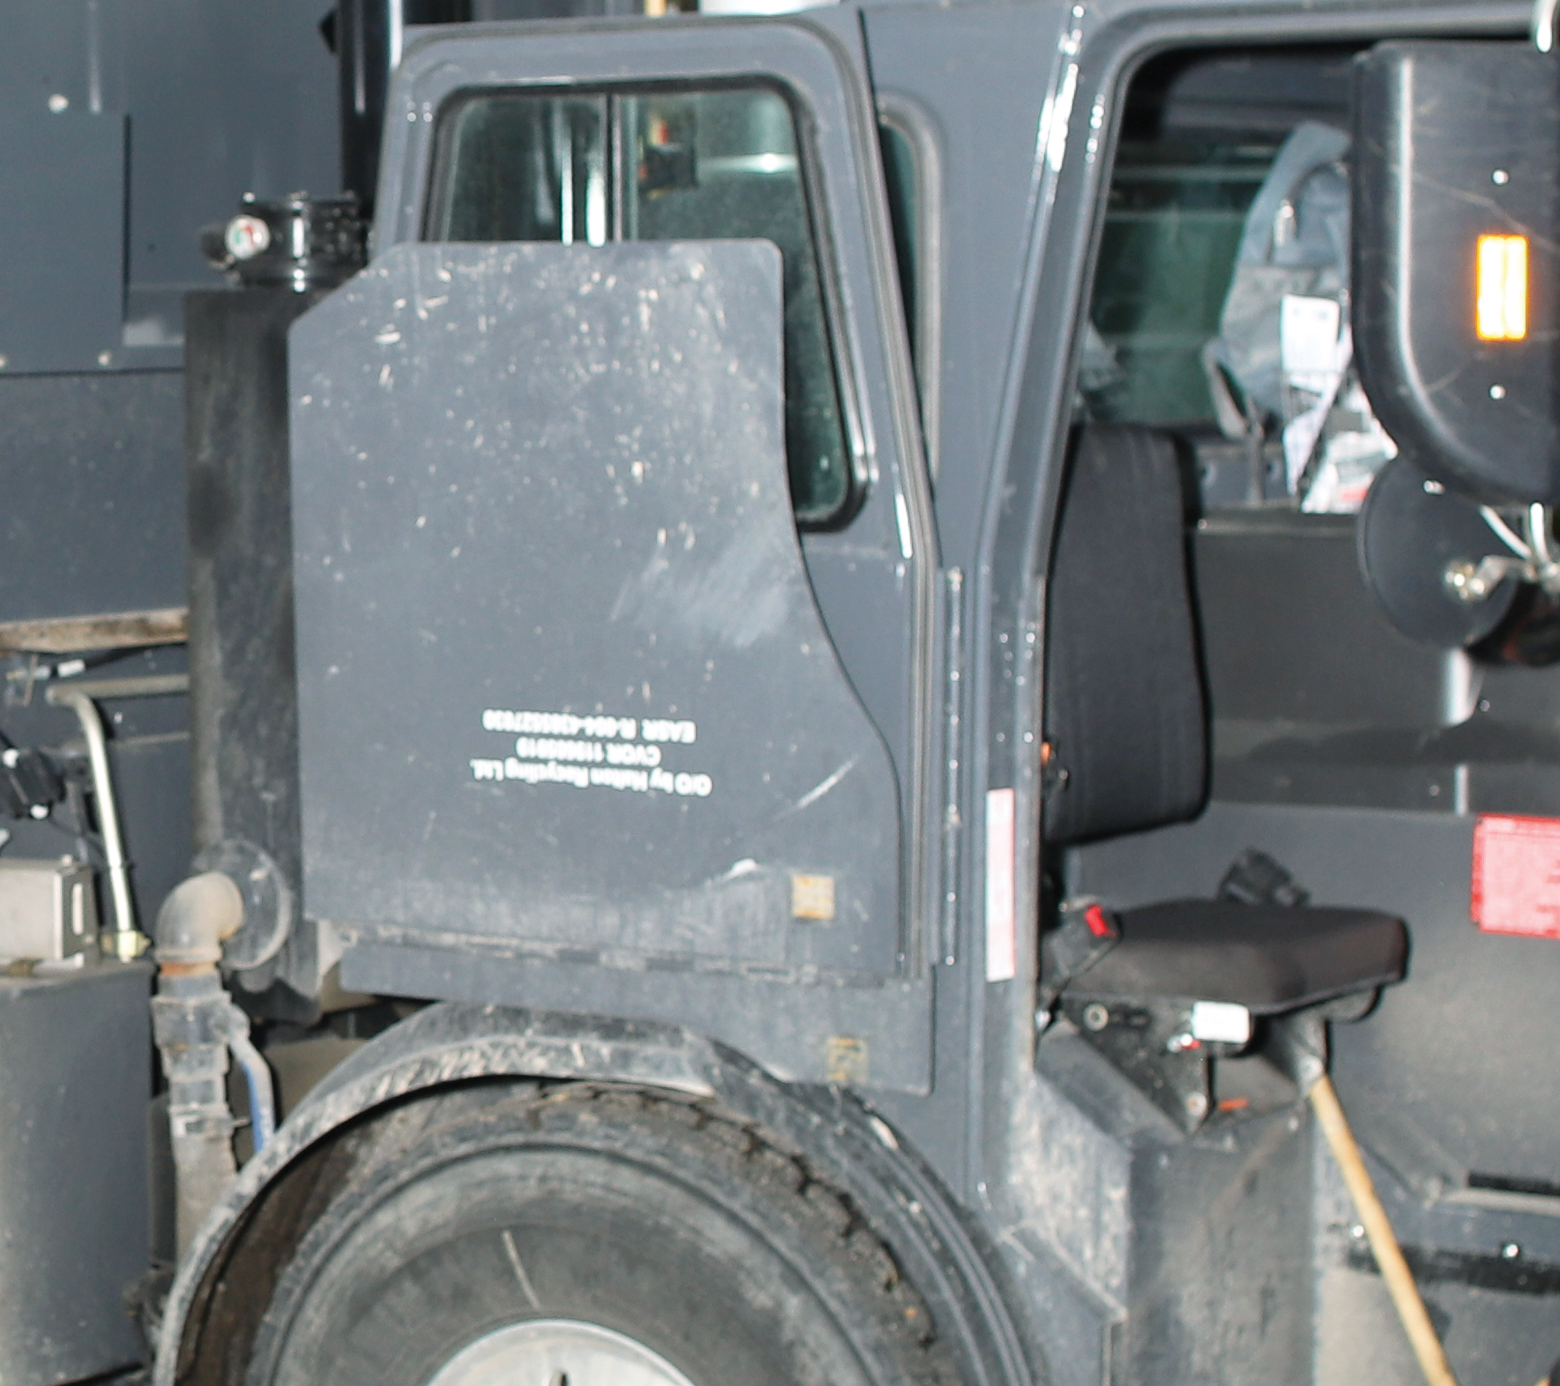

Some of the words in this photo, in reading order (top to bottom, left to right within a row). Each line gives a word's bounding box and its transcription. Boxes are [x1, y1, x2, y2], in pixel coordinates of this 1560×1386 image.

[642, 718, 697, 744] EASR
[606, 742, 662, 767] CVOR
[504, 756, 589, 788] Recycling
[650, 767, 674, 794] by
